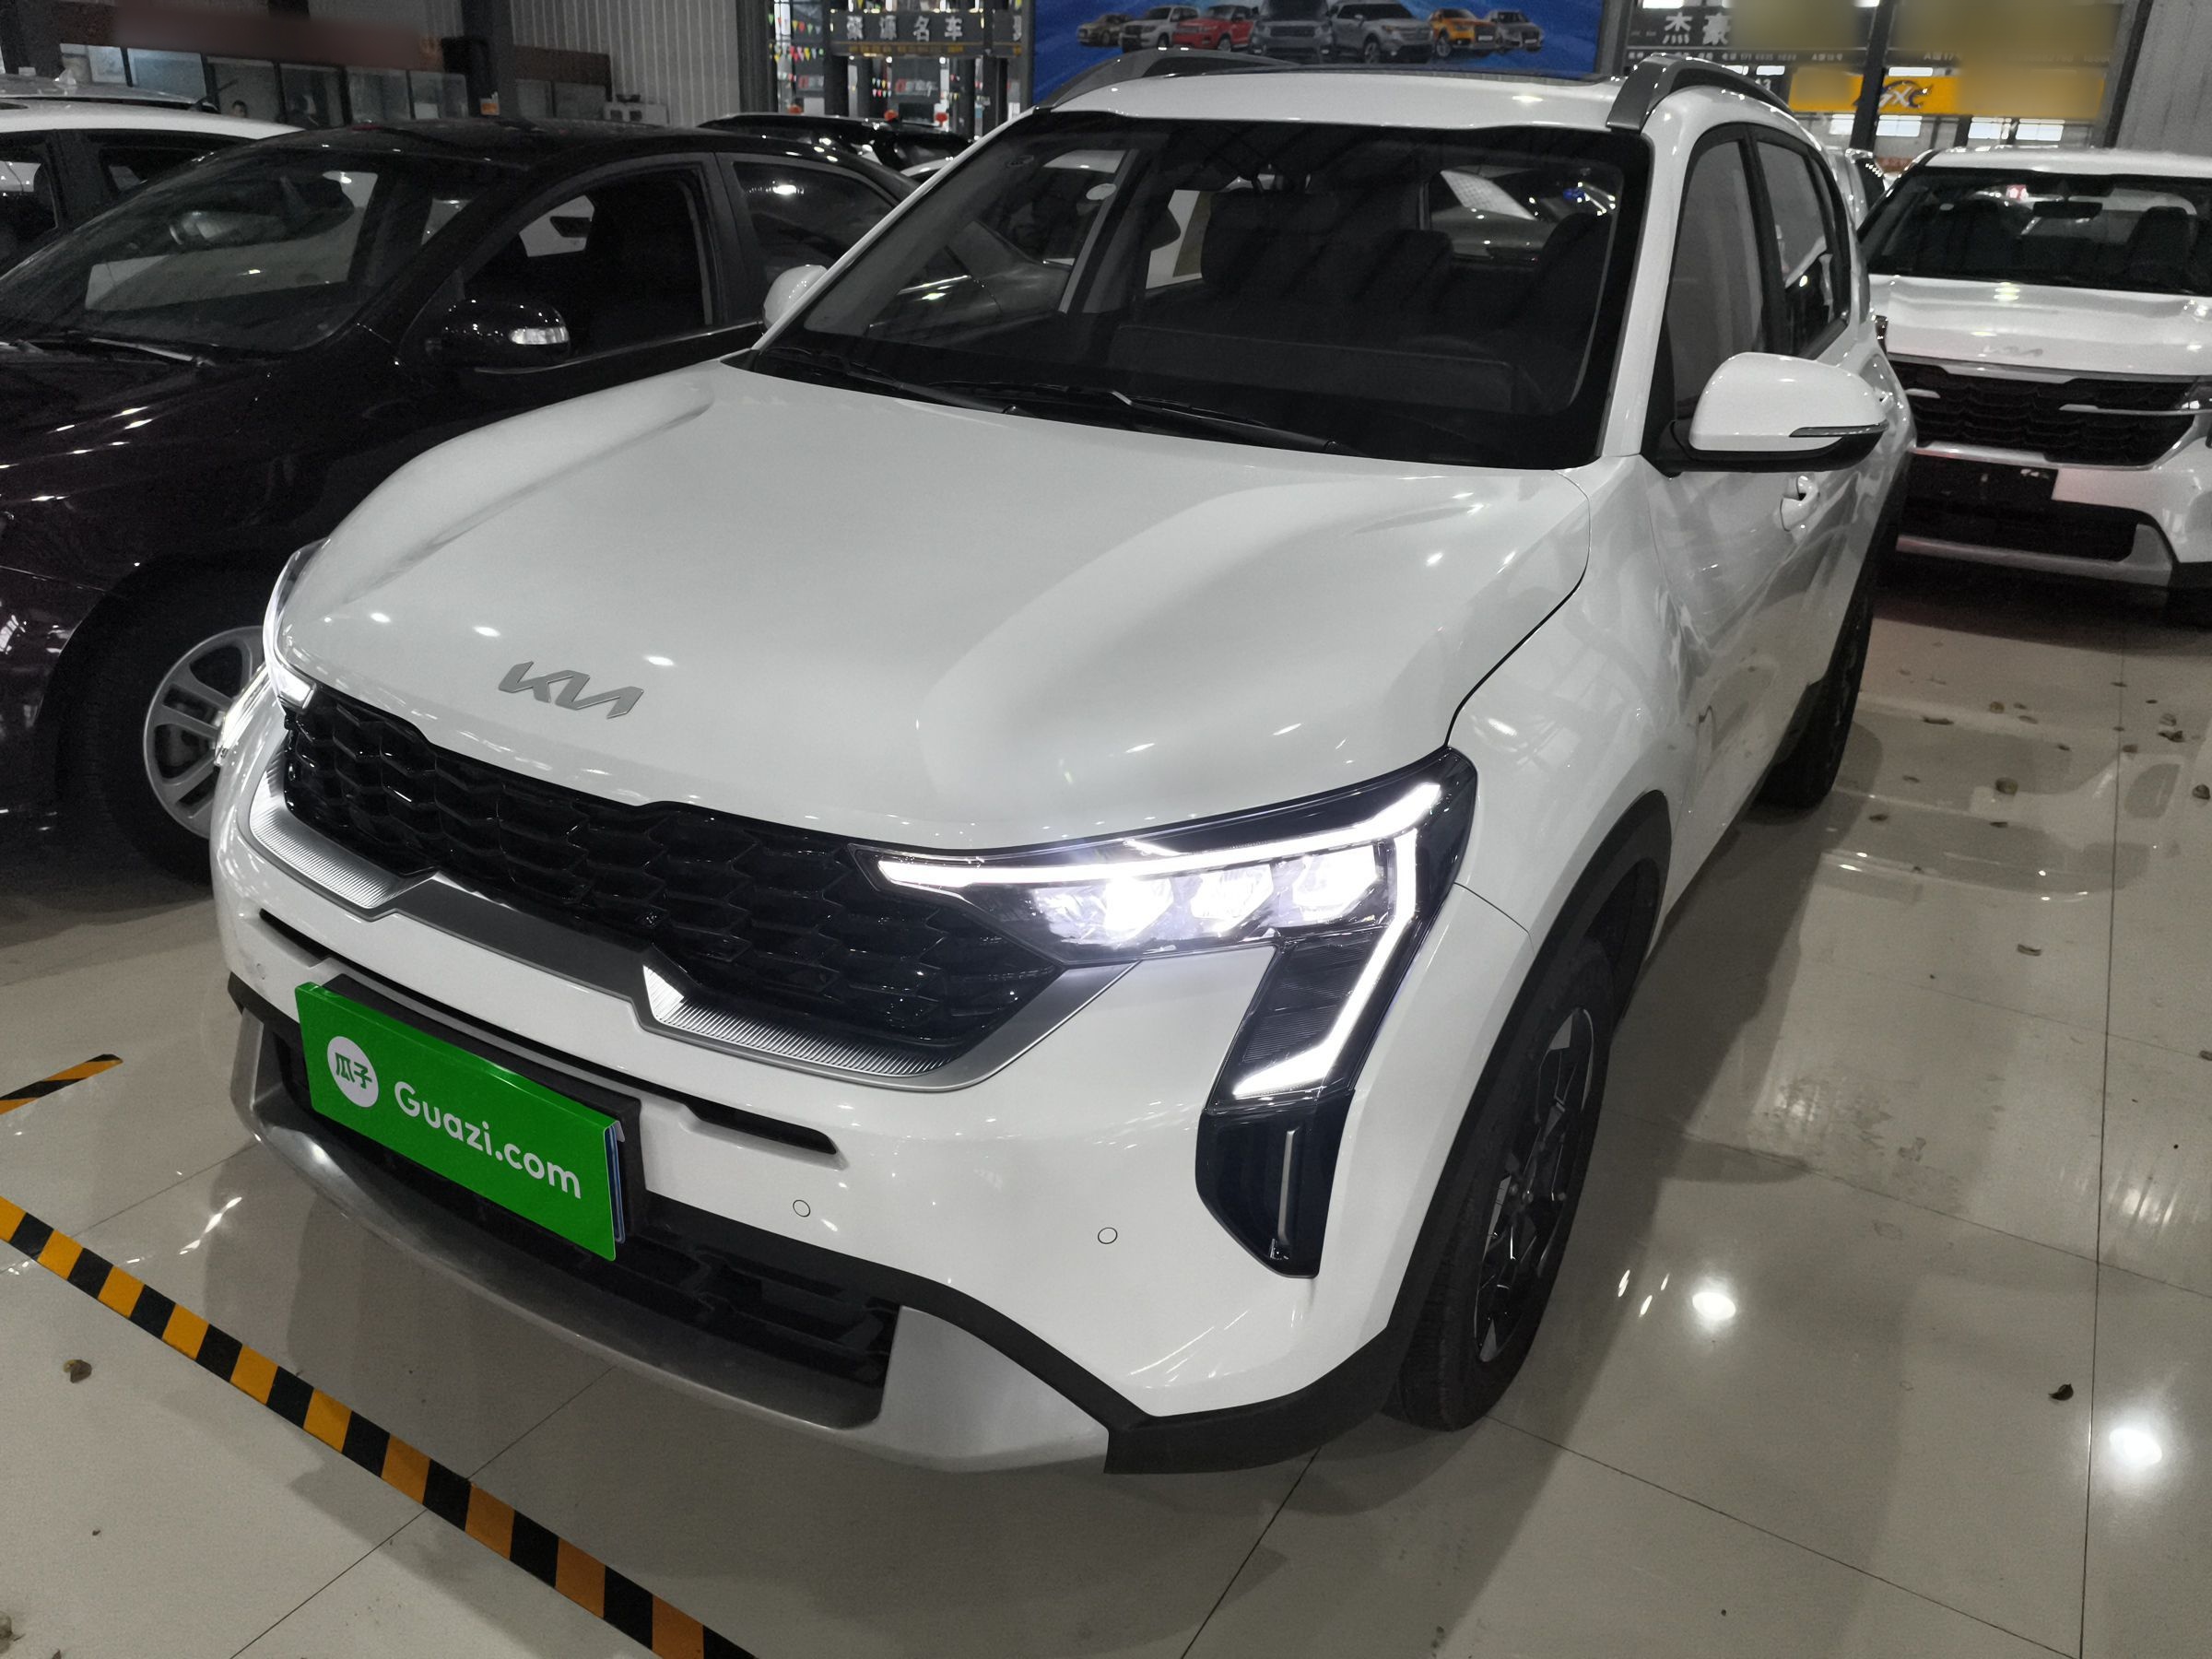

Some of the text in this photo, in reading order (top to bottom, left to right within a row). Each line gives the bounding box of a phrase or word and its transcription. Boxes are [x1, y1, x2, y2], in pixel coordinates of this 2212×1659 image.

[499, 661, 644, 719] KIA
[335, 1052, 373, 1089] 瓜子
[394, 1081, 582, 1199] Guazi.com
